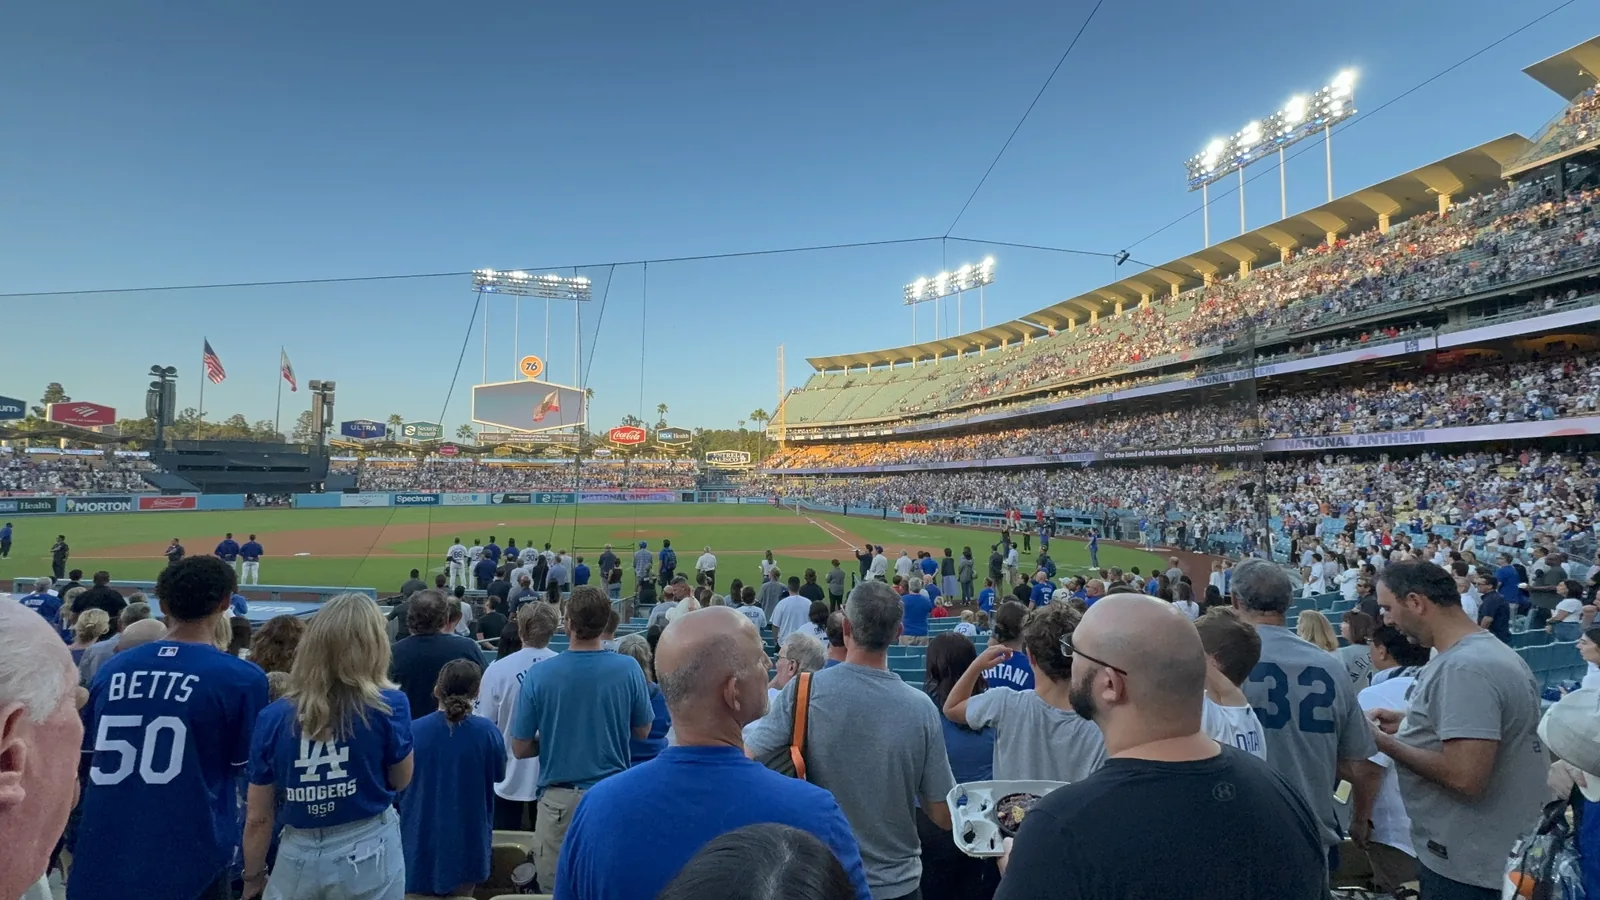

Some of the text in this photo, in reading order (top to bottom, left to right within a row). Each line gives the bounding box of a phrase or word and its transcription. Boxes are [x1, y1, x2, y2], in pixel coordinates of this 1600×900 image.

[525, 362, 538, 371] 76
[1186, 373, 1230, 387] NATIONAL
[1284, 432, 1425, 449] NATIONAL ANTHEM
[1193, 446, 1213, 454] home
[20, 502, 51, 510] Health
[396, 495, 434, 503] Spectrum
[75, 502, 131, 512] MORTON
[108, 671, 200, 702] BETTS
[1249, 662, 1336, 734] 32
[90, 714, 187, 785] 50
[286, 778, 358, 802] DODGERS
[307, 801, 335, 815] 1958
